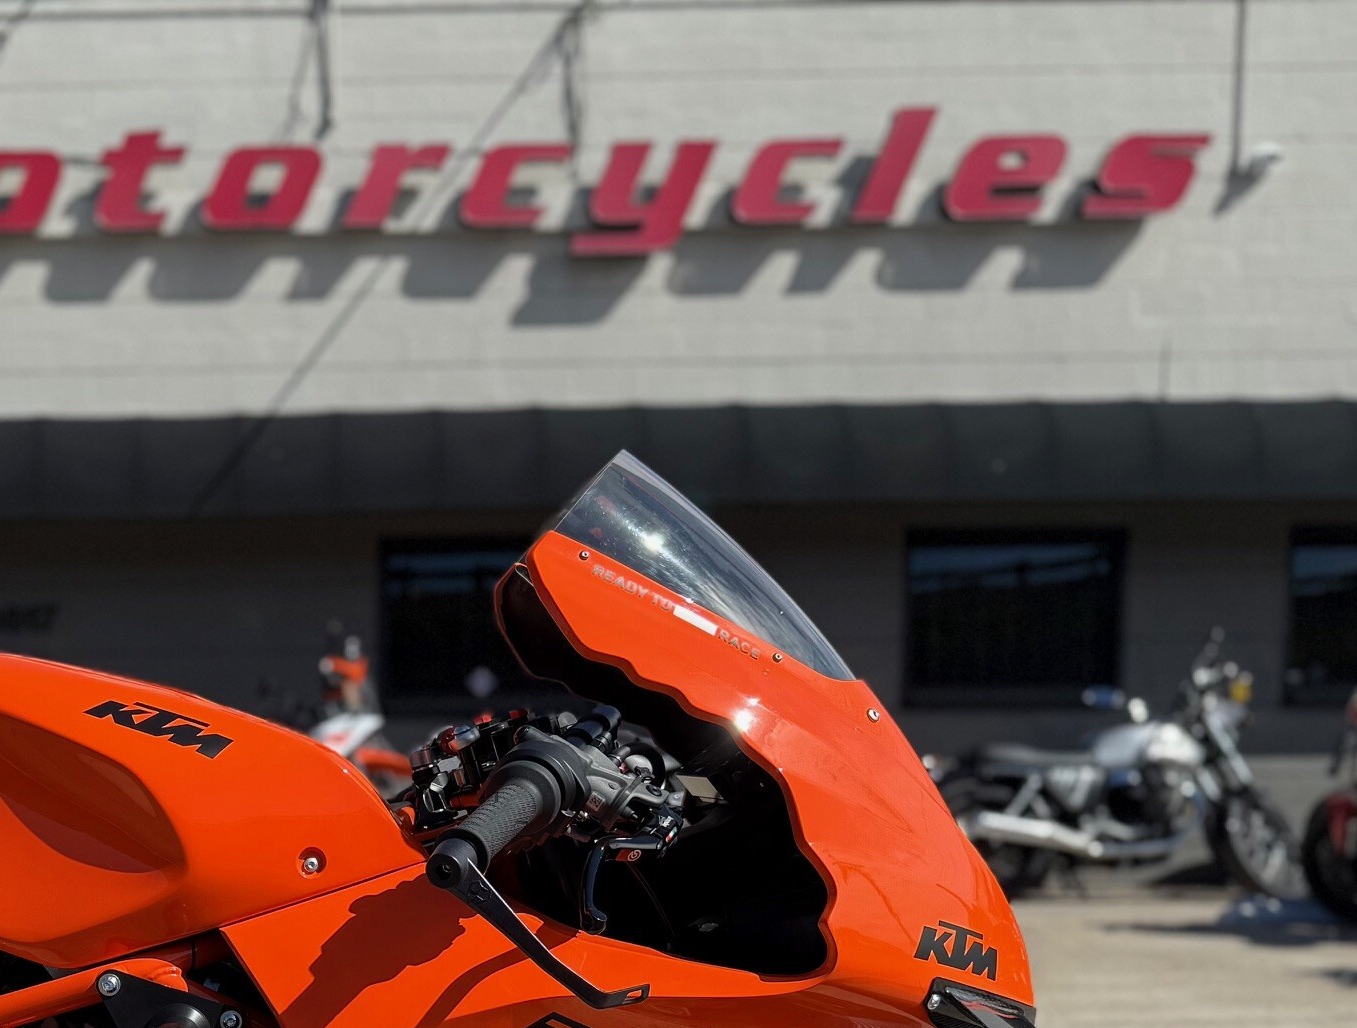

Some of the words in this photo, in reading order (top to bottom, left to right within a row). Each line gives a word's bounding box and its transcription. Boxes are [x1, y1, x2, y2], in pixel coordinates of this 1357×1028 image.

[592, 564, 650, 599] READY
[651, 594, 674, 612] TO
[717, 628, 762, 660] RACE
[82, 699, 234, 759] KTM
[913, 919, 998, 981] KTM
